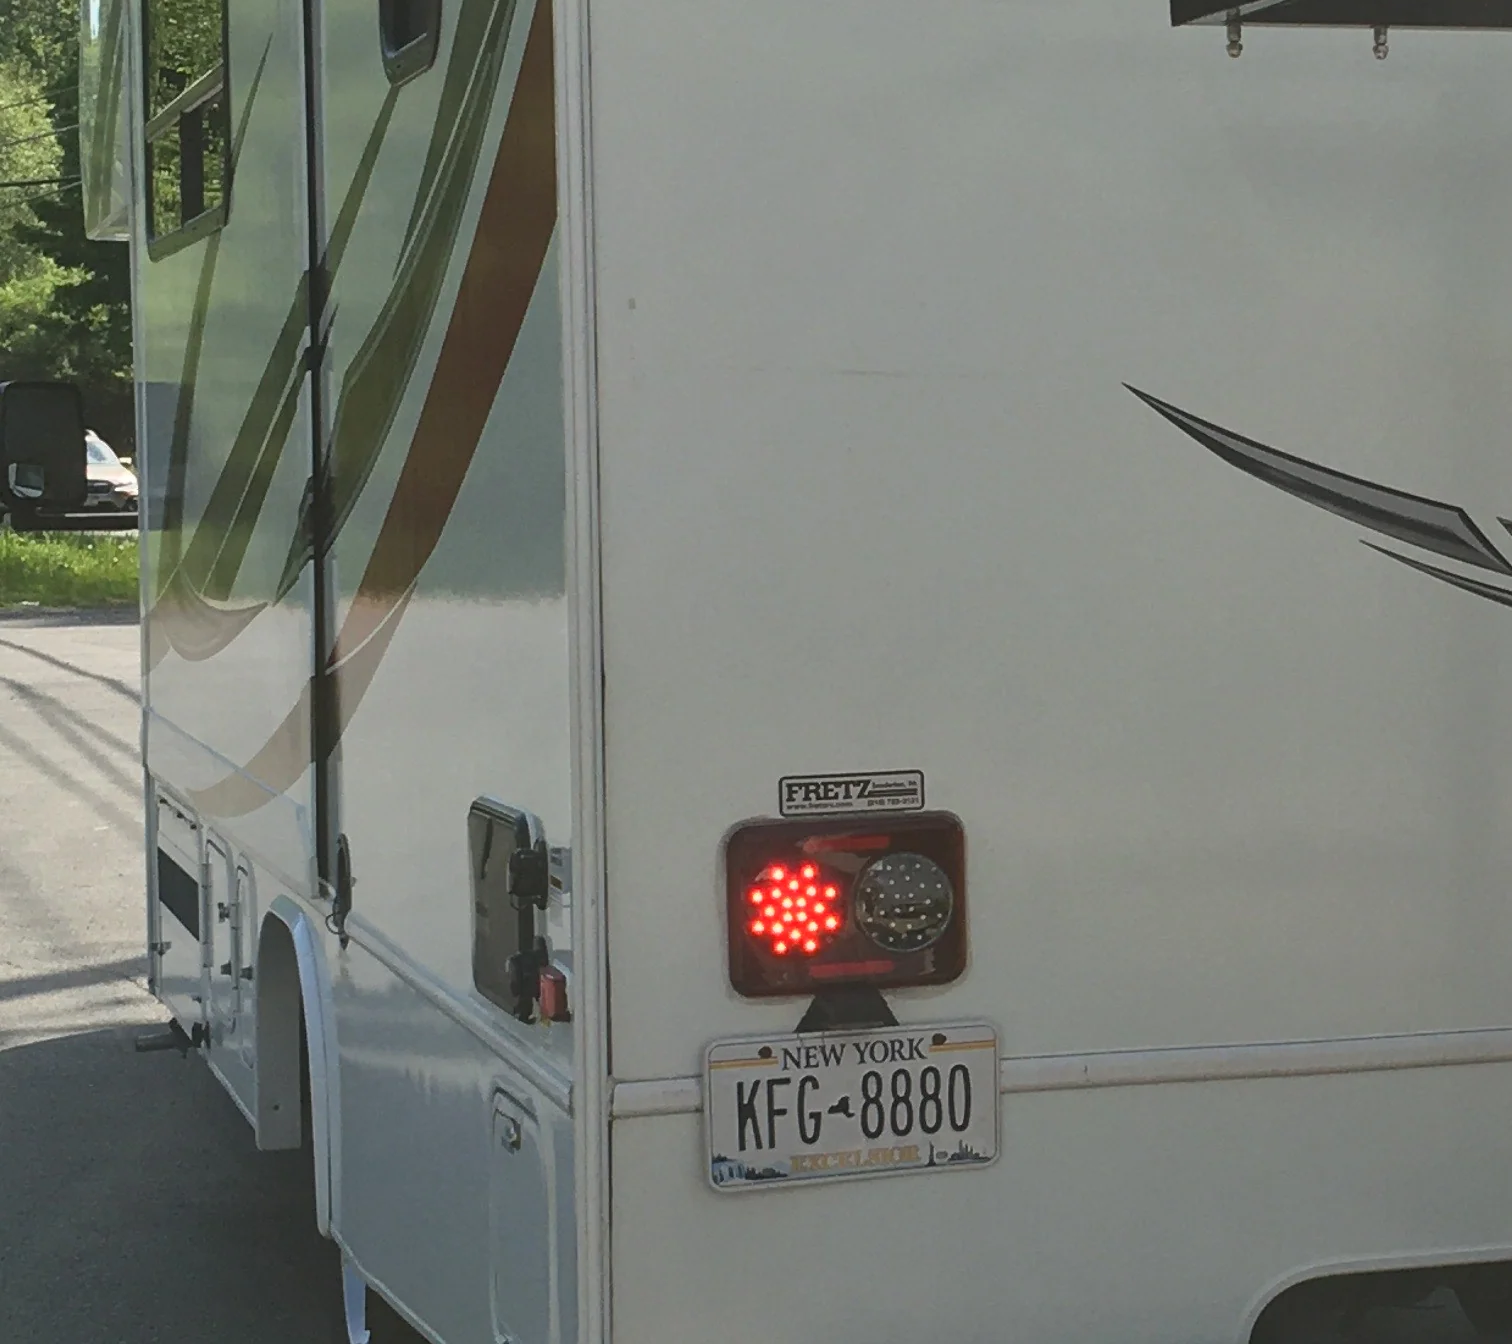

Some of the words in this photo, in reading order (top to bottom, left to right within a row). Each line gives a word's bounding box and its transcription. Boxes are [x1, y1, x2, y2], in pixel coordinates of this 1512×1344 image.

[785, 779, 872, 802] FRETZ
[781, 1043, 846, 1071] NEW
[852, 1037, 928, 1065] YORK
[736, 1075, 823, 1152] KFG
[860, 1064, 972, 1140] 8880
